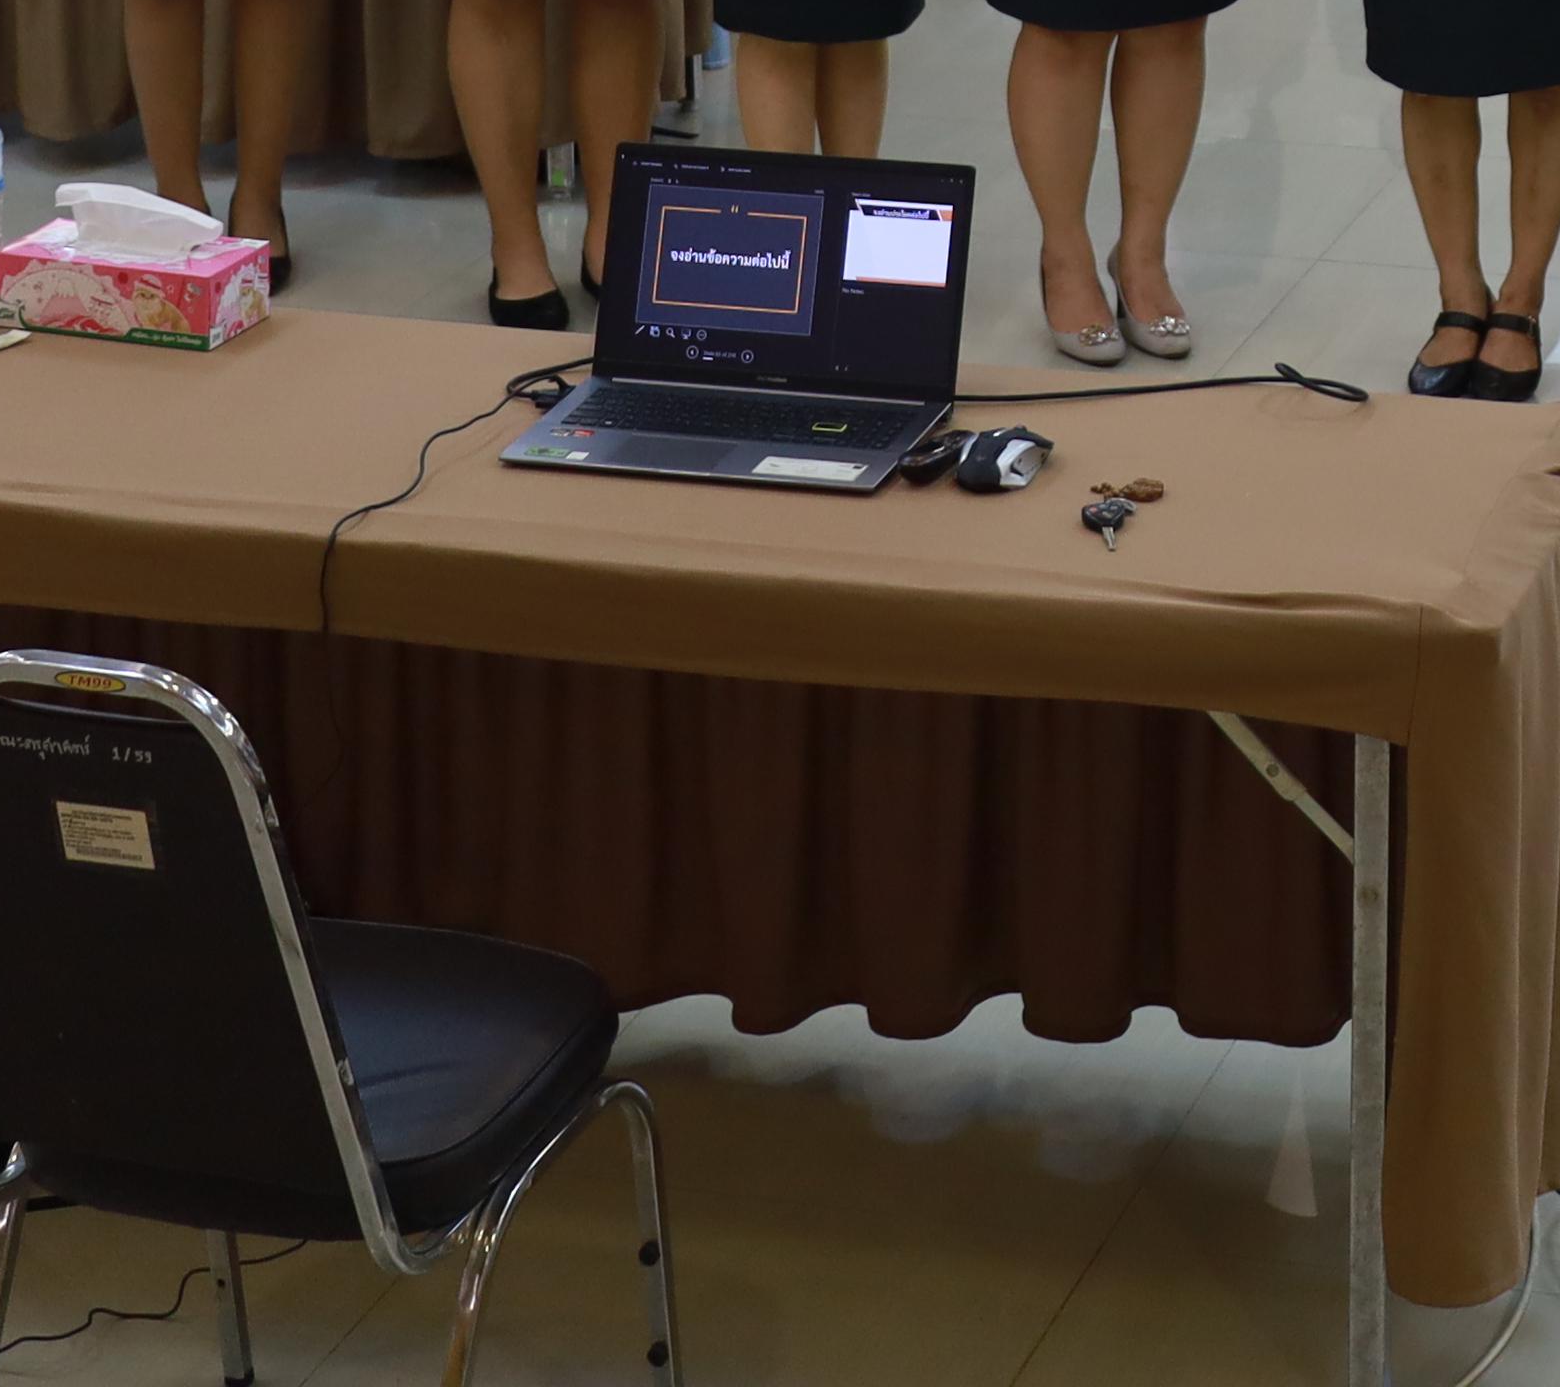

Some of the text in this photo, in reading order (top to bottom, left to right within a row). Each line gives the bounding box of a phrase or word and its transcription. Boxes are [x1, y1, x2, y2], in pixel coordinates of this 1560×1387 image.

[670, 247, 792, 269] จงอ่านข้อความต่อไปนี้
[68, 674, 112, 689] TM99
